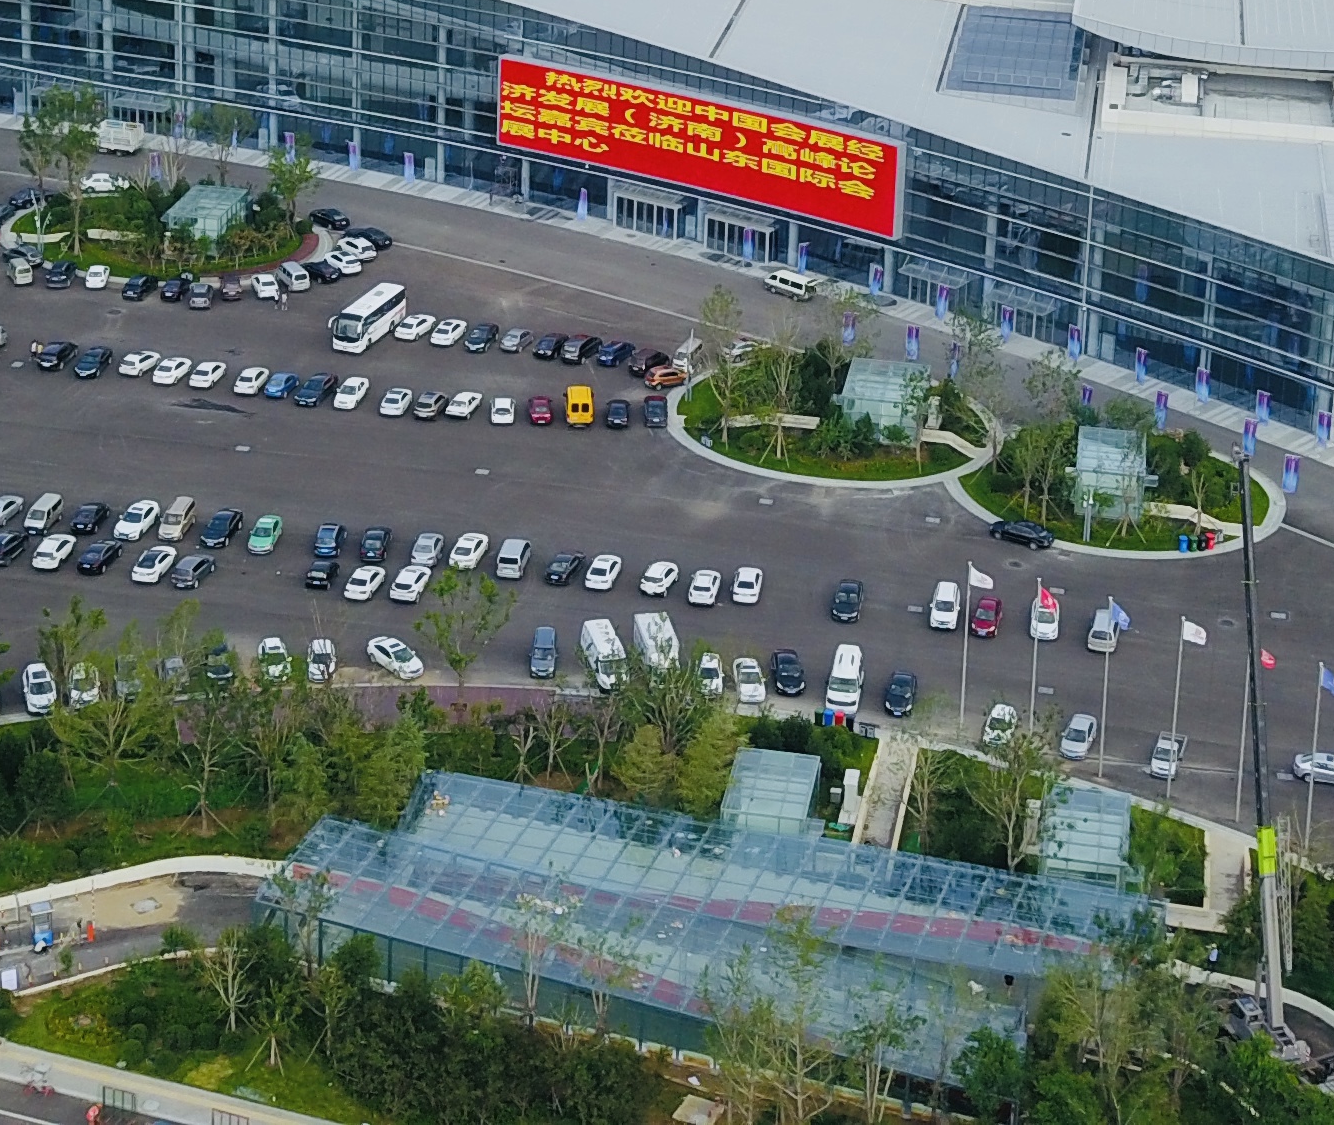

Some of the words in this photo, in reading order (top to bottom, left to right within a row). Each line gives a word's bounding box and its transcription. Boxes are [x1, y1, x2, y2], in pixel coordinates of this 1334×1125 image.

[500, 100, 875, 200] 坛嘉宾莅临山东国际会
[501, 119, 610, 154] 展中心
[545, 71, 884, 163] 热烈欢迎中国会展经
